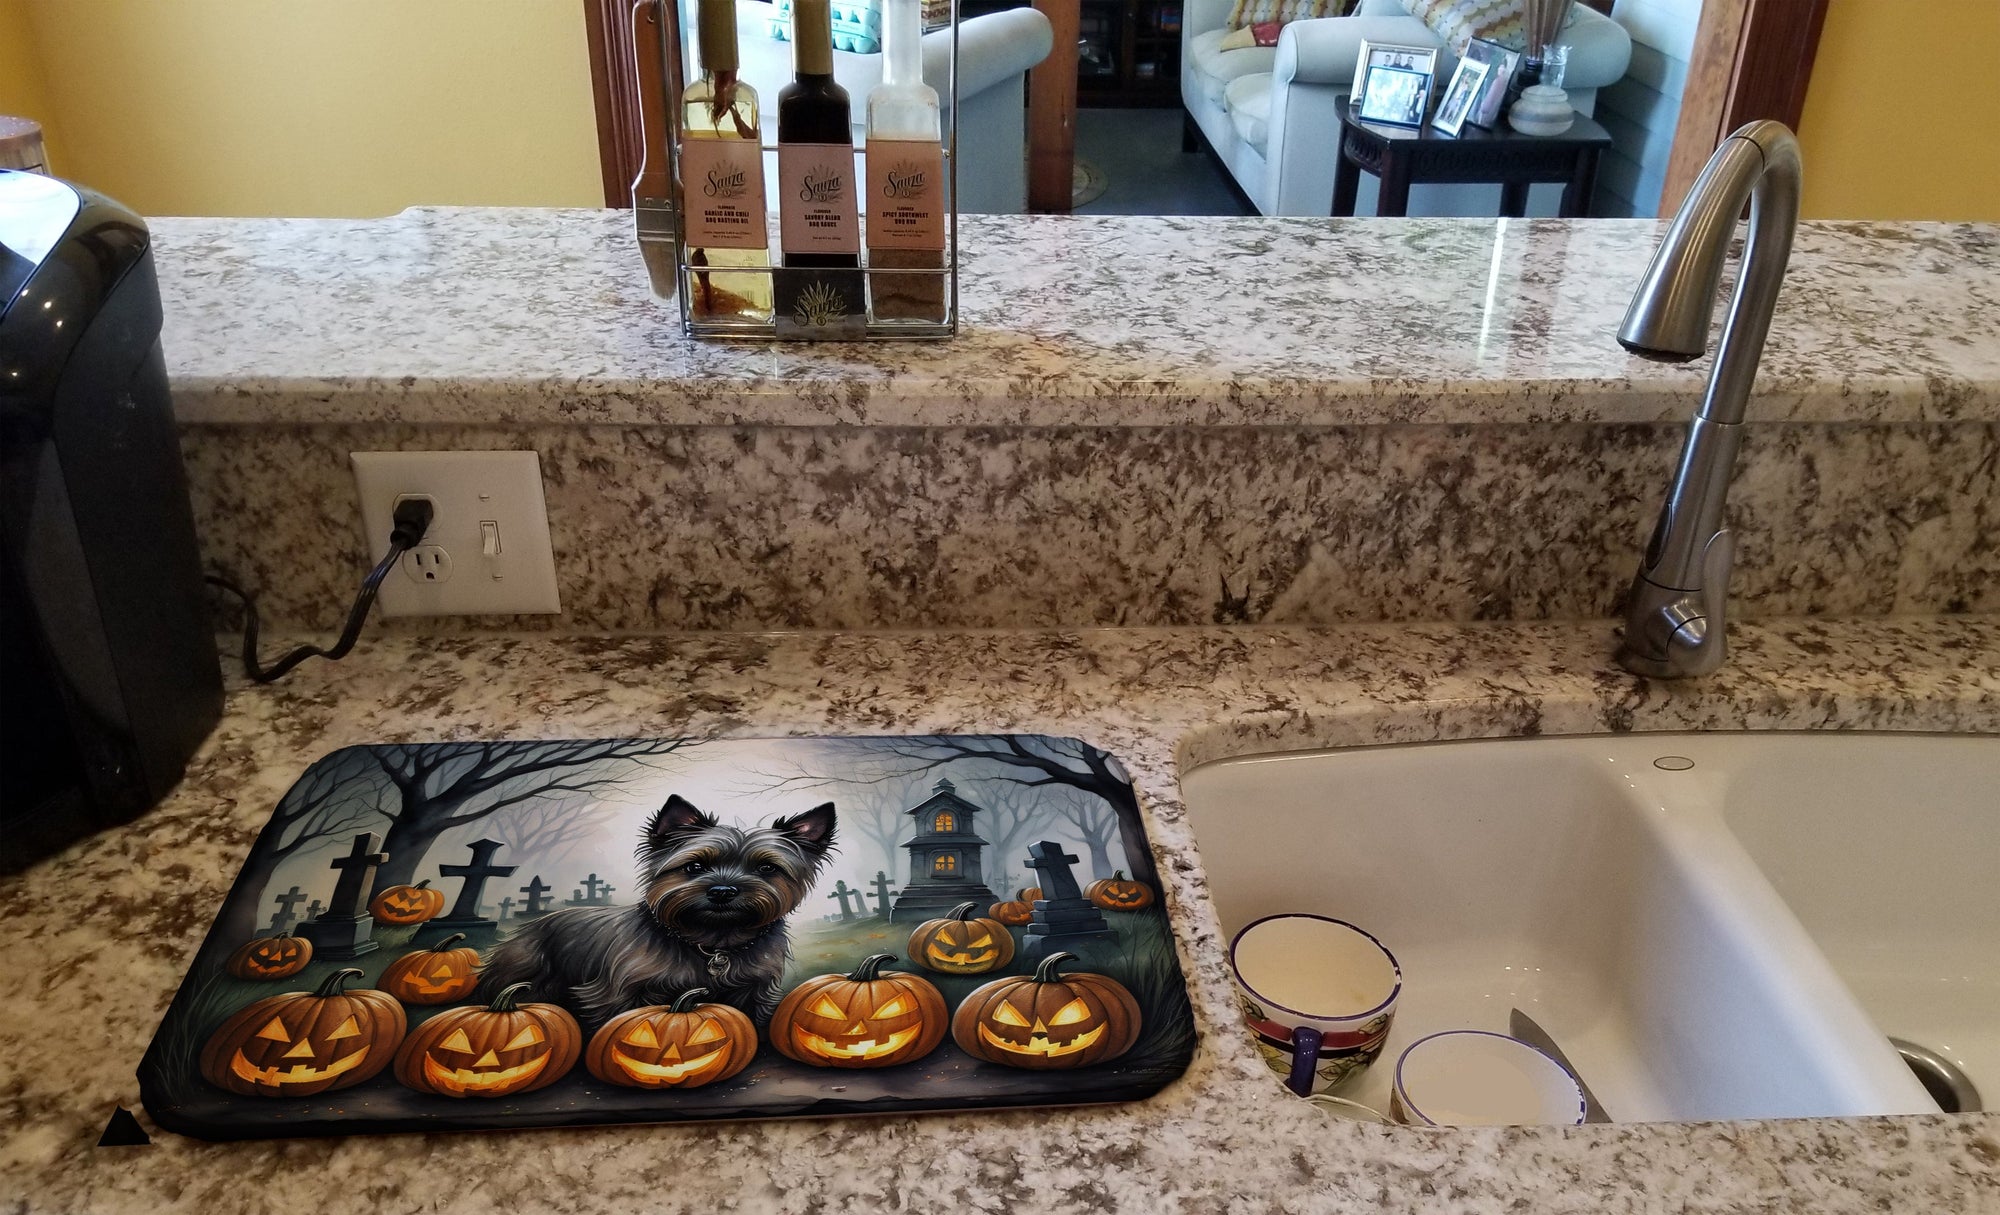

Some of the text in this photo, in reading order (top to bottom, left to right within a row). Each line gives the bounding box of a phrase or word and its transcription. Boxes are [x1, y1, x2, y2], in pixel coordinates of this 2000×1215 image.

[704, 170, 746, 197] Sauza
[800, 175, 842, 202] Sauza
[883, 171, 925, 198] Sauza
